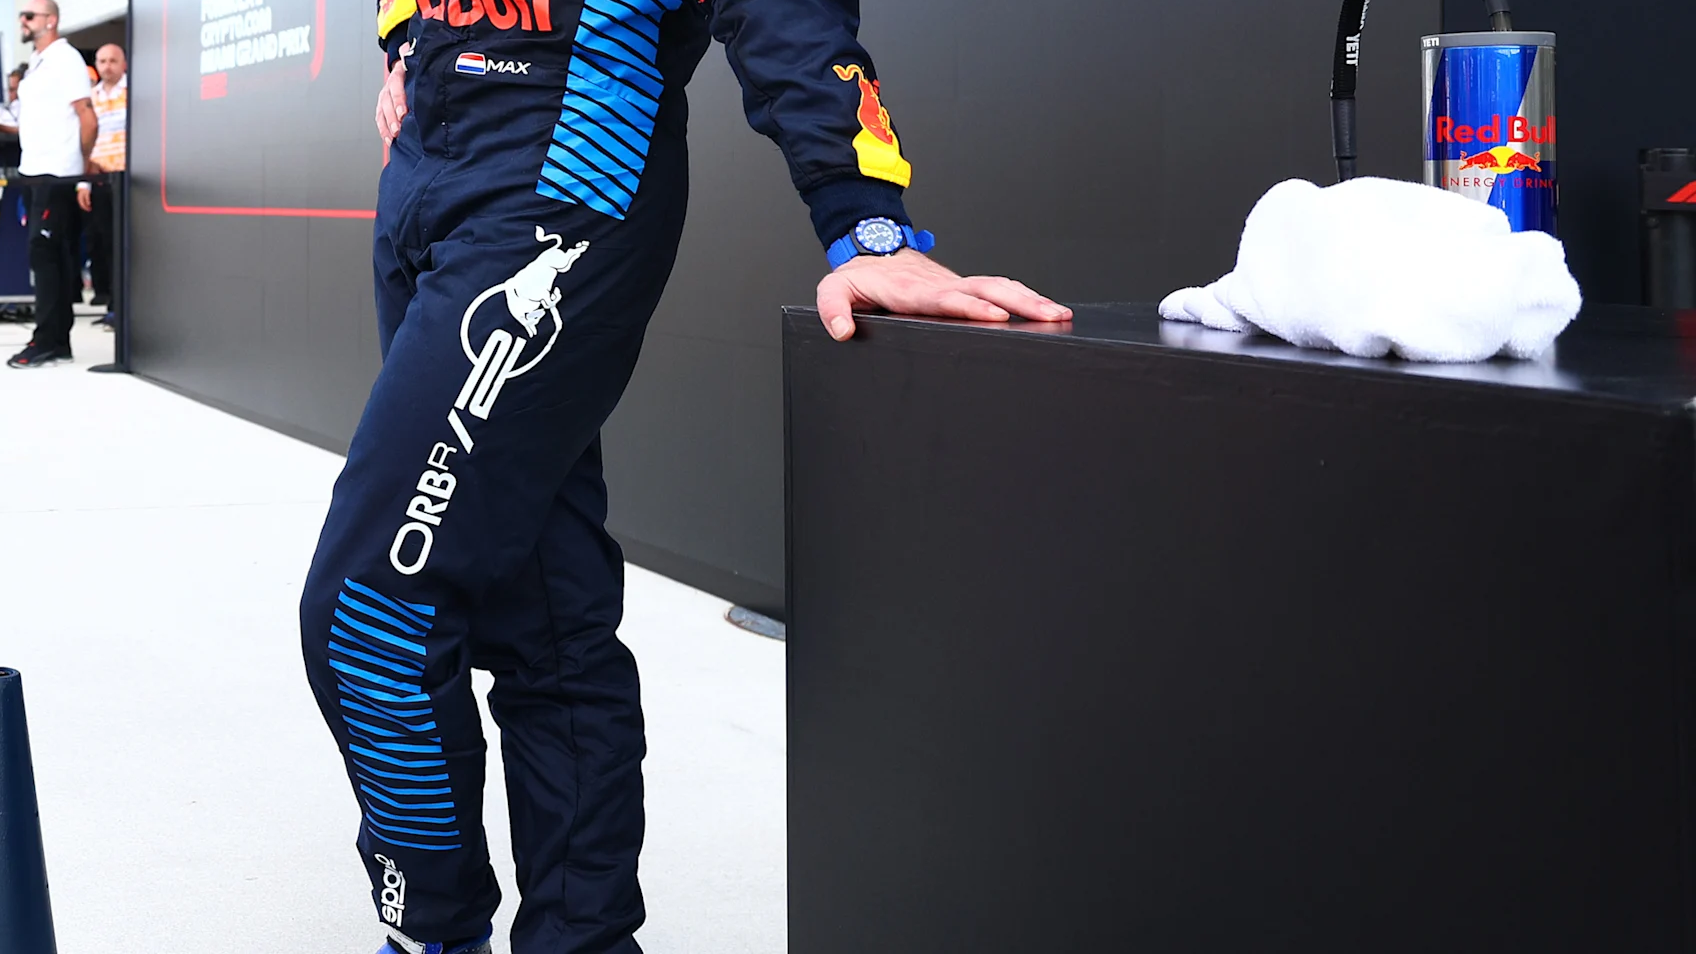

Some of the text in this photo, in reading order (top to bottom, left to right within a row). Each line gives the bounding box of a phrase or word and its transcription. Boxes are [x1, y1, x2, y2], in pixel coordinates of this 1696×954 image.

[1346, 33, 1361, 66] YETI
[1422, 37, 1440, 47] YETI
[486, 59, 532, 75] MAX
[1436, 114, 1501, 144] Red
[1442, 177, 1506, 188] ENERGY
